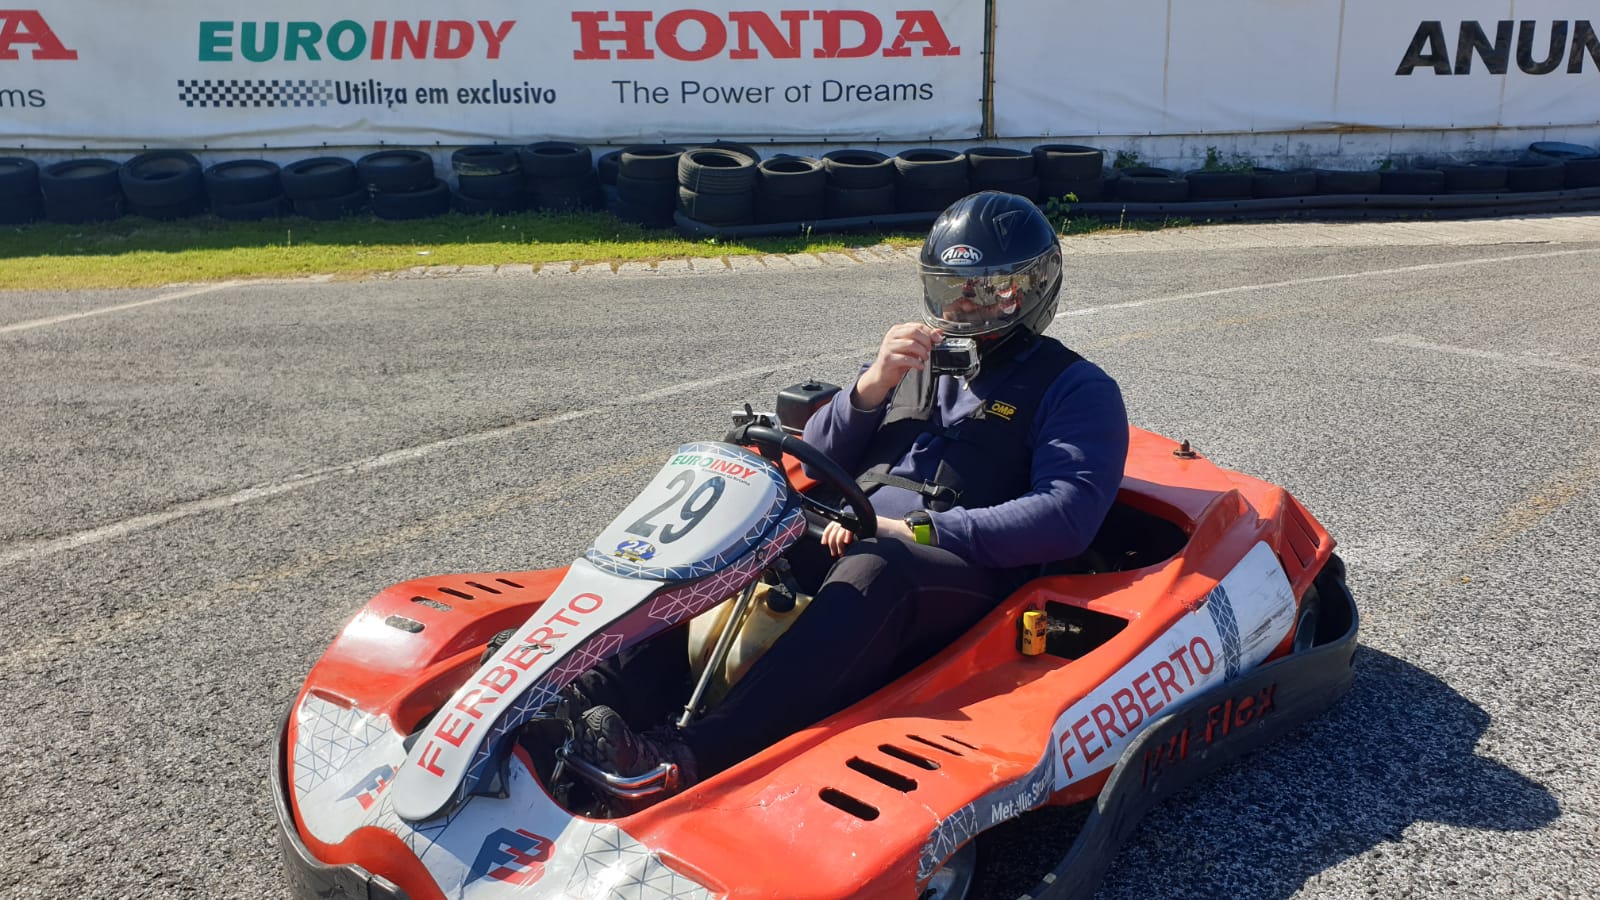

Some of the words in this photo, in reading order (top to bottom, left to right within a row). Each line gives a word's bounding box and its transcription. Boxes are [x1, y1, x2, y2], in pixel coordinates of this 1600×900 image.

[198, 20, 517, 62] EUROINDY
[571, 9, 961, 61] HONDA
[415, 87, 449, 104] em
[457, 79, 556, 104] exclusivo
[611, 80, 669, 104] The
[681, 80, 775, 104] Power
[823, 79, 934, 102] Dreams
[943, 247, 979, 261] Airoh
[992, 402, 1015, 416] OMP
[671, 455, 758, 479] EUROINDY
[624, 469, 726, 544] 29
[417, 592, 604, 778] FERBERTO
[1058, 636, 1215, 779] FERBERTO
